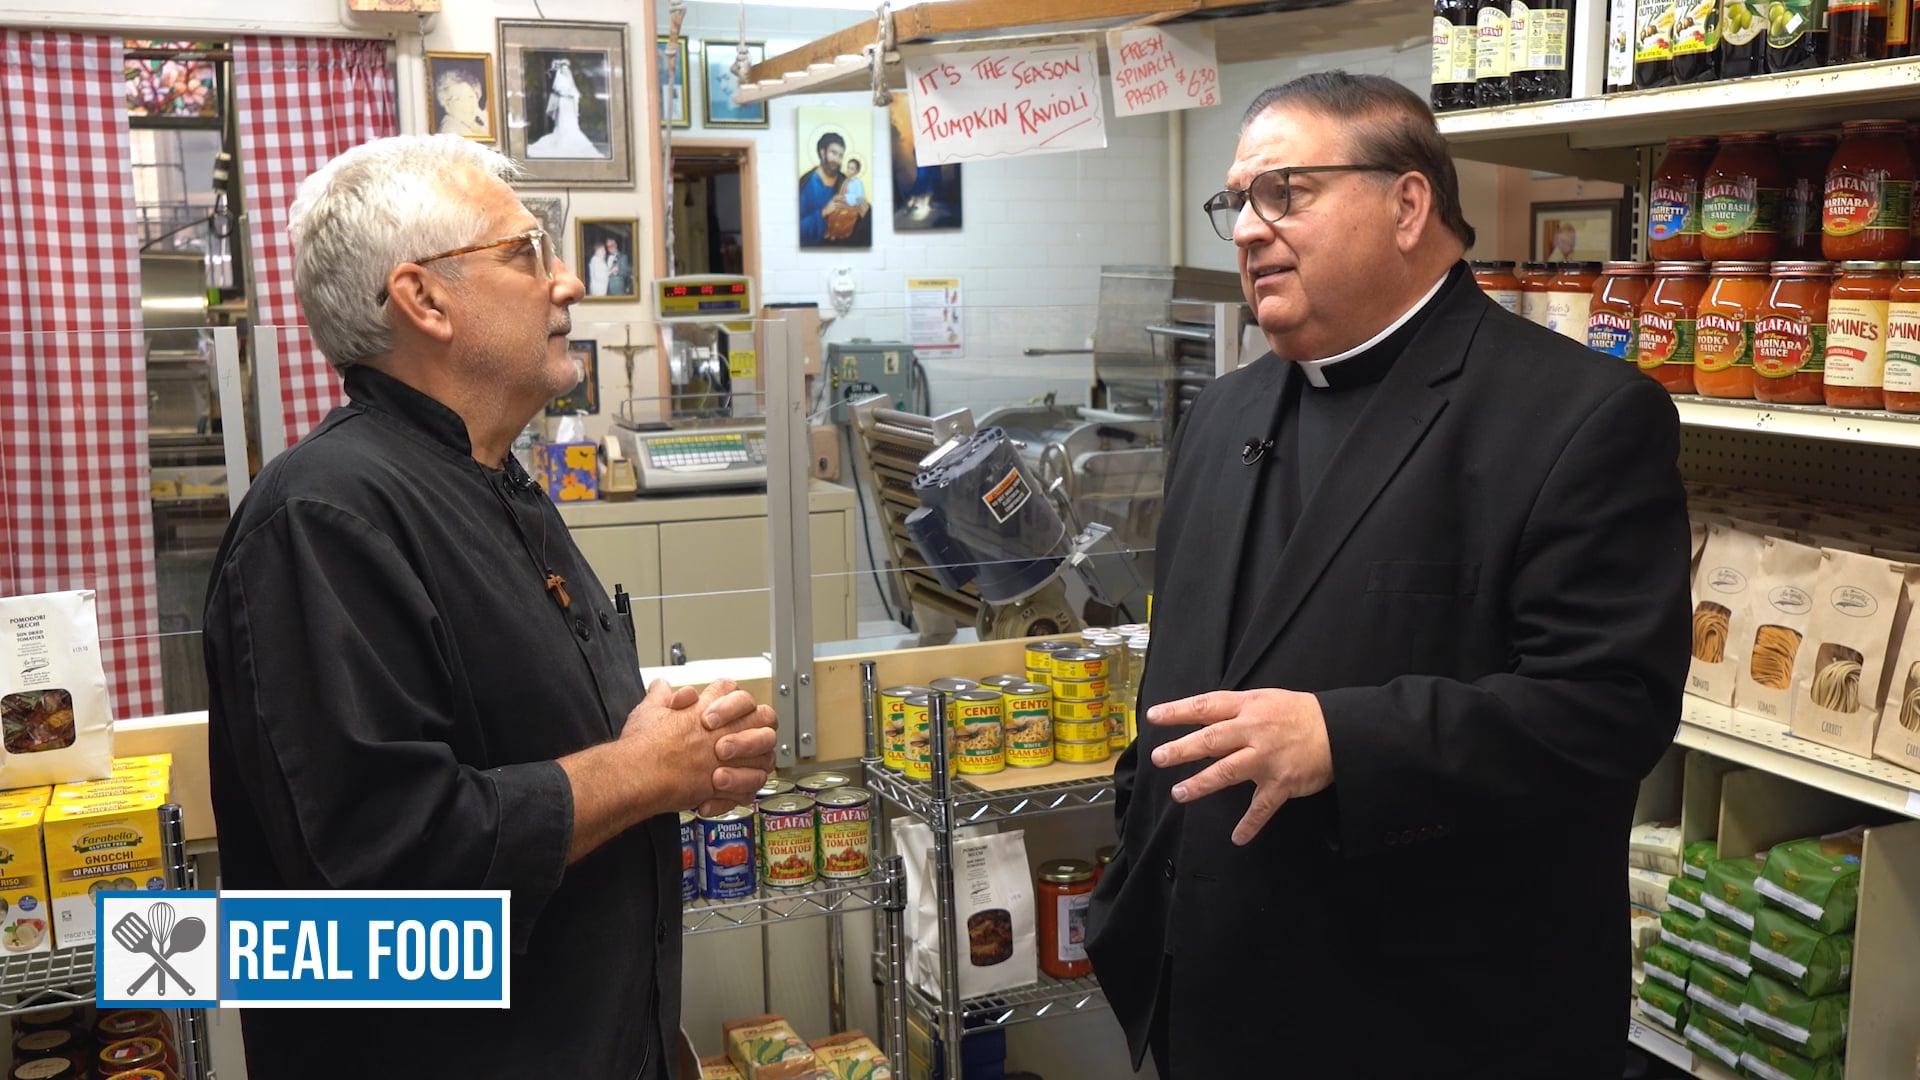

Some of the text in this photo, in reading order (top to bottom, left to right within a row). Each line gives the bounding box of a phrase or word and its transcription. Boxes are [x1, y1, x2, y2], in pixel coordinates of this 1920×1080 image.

[1120, 33, 1163, 66] FRESH
[971, 56, 1009, 80] THE
[1012, 56, 1080, 89] SEASON
[1115, 50, 1176, 88] SPINACH
[1124, 80, 1168, 110] PASTA
[1727, 202, 1750, 212] BASIL
[1829, 206, 1856, 215] SAUCE
[1755, 318, 1808, 337] SCLAFANI
[1591, 340, 1615, 350] SAUCE
[1700, 343, 1724, 353] SAUCE
[1754, 339, 1802, 351] MARINARA
[1760, 348, 1788, 358] SAUCE
[9, 614, 47, 624] POMODORI
[17, 621, 41, 630] SECCHI
[1013, 700, 1049, 710] CENTO
[964, 706, 1000, 717] CENTO
[1008, 749, 1031, 757] CLAM
[959, 755, 981, 765] CLAM
[821, 809, 869, 825] SCLAFANI
[718, 822, 742, 832] Poma
[764, 815, 814, 832] SCLAFANI
[83, 831, 133, 846] Farabella
[719, 830, 742, 840] Rosa
[825, 831, 845, 839] SWEET
[89, 842, 111, 851] GLUTEN
[826, 836, 868, 849] TOMATOES
[770, 844, 812, 856] TOMATOES
[85, 850, 134, 865] GNOCCHI
[73, 860, 149, 878] DI PATATE CON RISO
[1, 877, 21, 888] RISO
